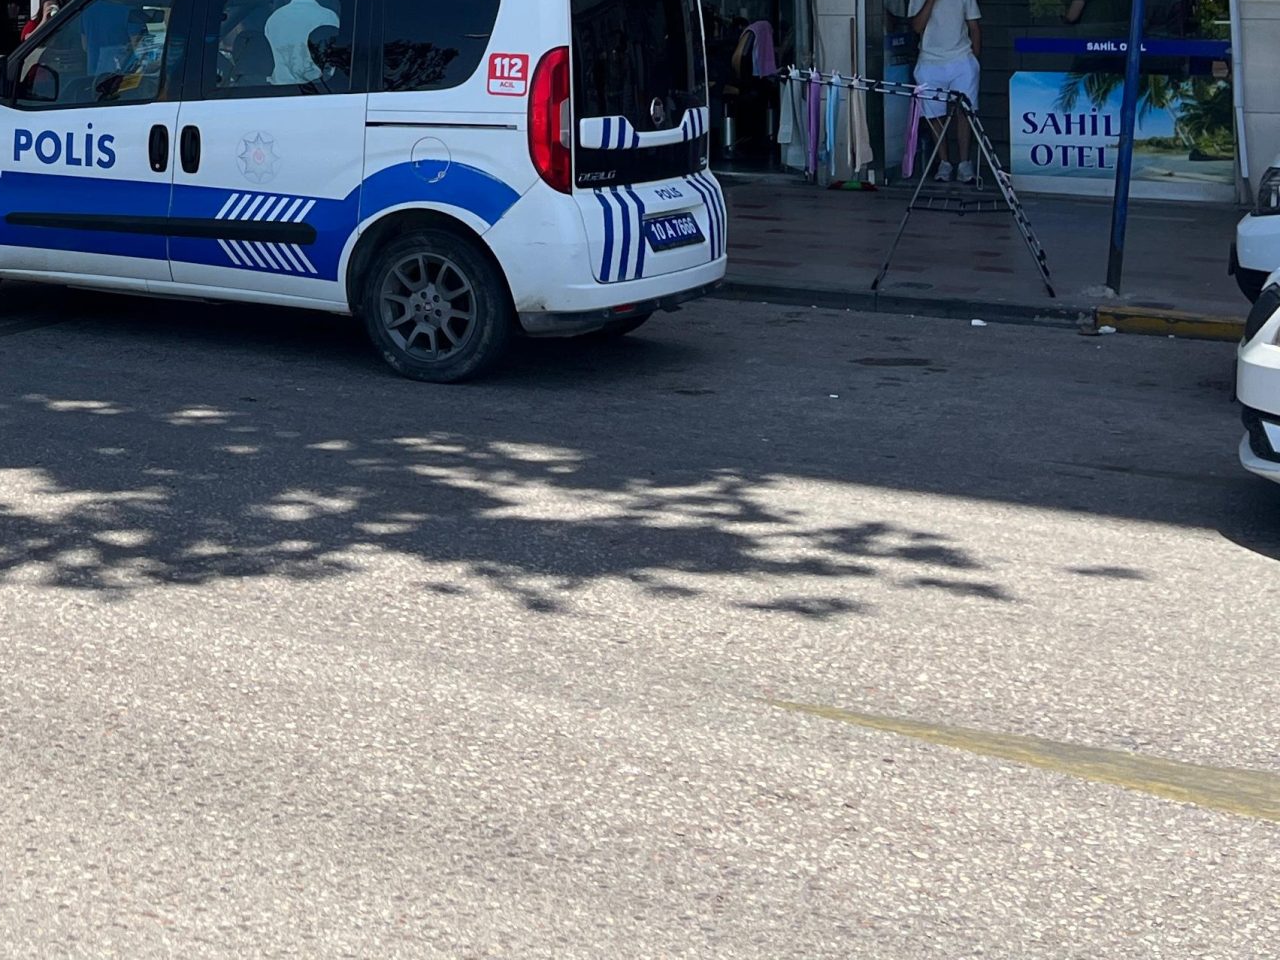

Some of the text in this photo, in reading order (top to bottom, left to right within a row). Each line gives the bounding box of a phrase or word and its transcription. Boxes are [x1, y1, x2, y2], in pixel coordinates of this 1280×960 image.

[1086, 40, 1146, 52] SAHİL OL
[494, 56, 522, 78] 112
[1022, 106, 1120, 138] SAHİL
[13, 122, 116, 169] POLİS
[1030, 143, 1116, 170] OTEL
[651, 224, 665, 241] 10
[665, 220, 675, 238] A
